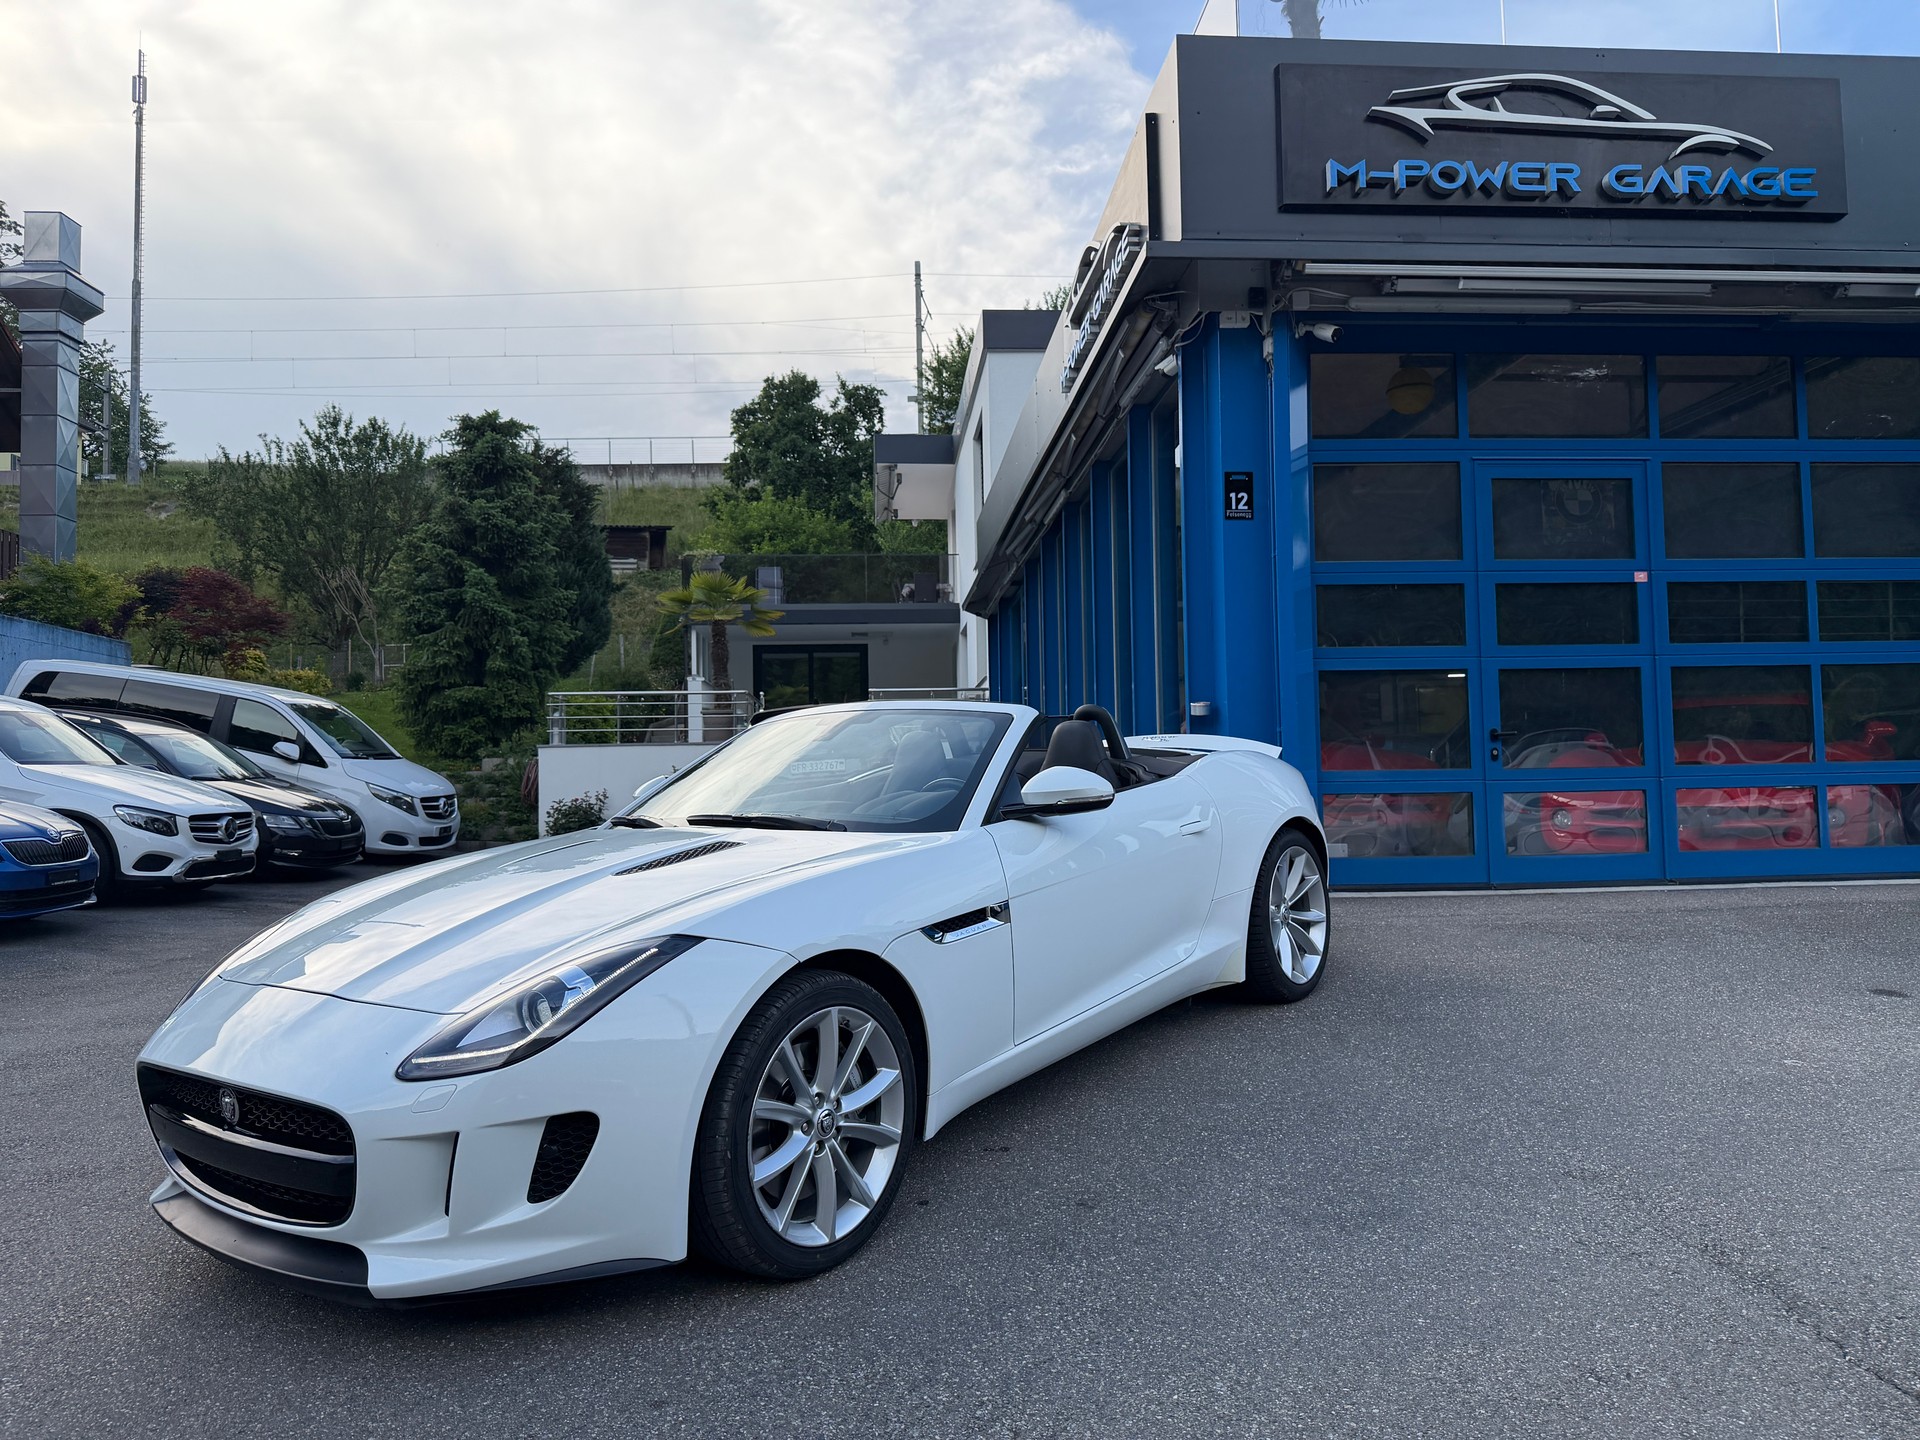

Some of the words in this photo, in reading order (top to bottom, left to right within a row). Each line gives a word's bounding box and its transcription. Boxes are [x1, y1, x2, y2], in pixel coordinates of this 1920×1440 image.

[1326, 158, 1582, 193] M-POWER
[1607, 164, 1819, 197] GARAGE
[1092, 225, 1130, 321] GARAGE
[1229, 492, 1249, 510] 12
[809, 761, 839, 771] 332767
